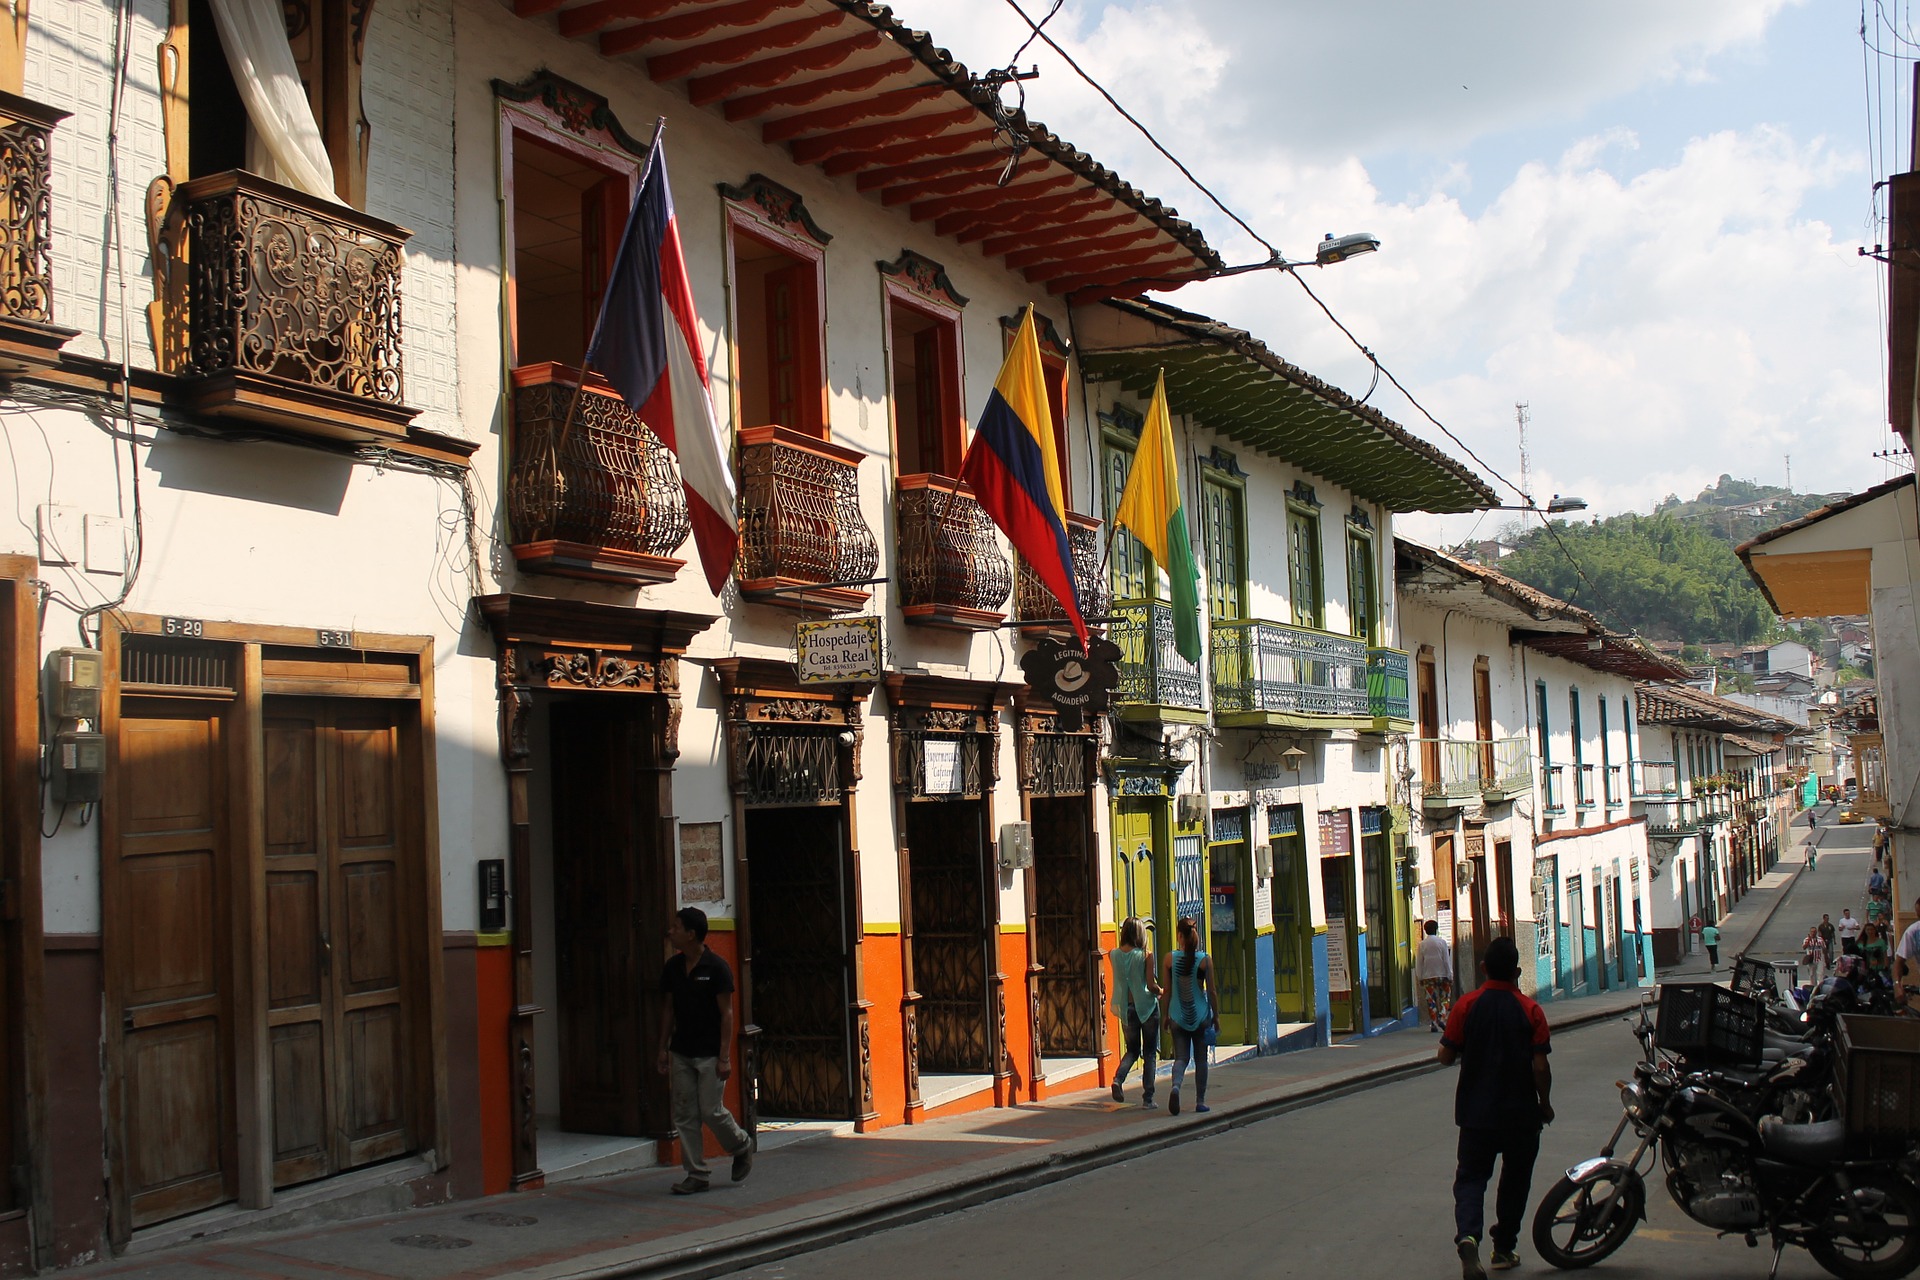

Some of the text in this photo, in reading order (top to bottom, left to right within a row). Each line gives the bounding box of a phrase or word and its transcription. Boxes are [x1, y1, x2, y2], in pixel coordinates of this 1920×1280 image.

[166, 618, 203, 637] 5-29
[320, 631, 350, 647] 5-31
[809, 630, 867, 651] Hospedaje
[809, 648, 869, 665] Casa Real
[1051, 691, 1090, 706] AGUADEÑO
